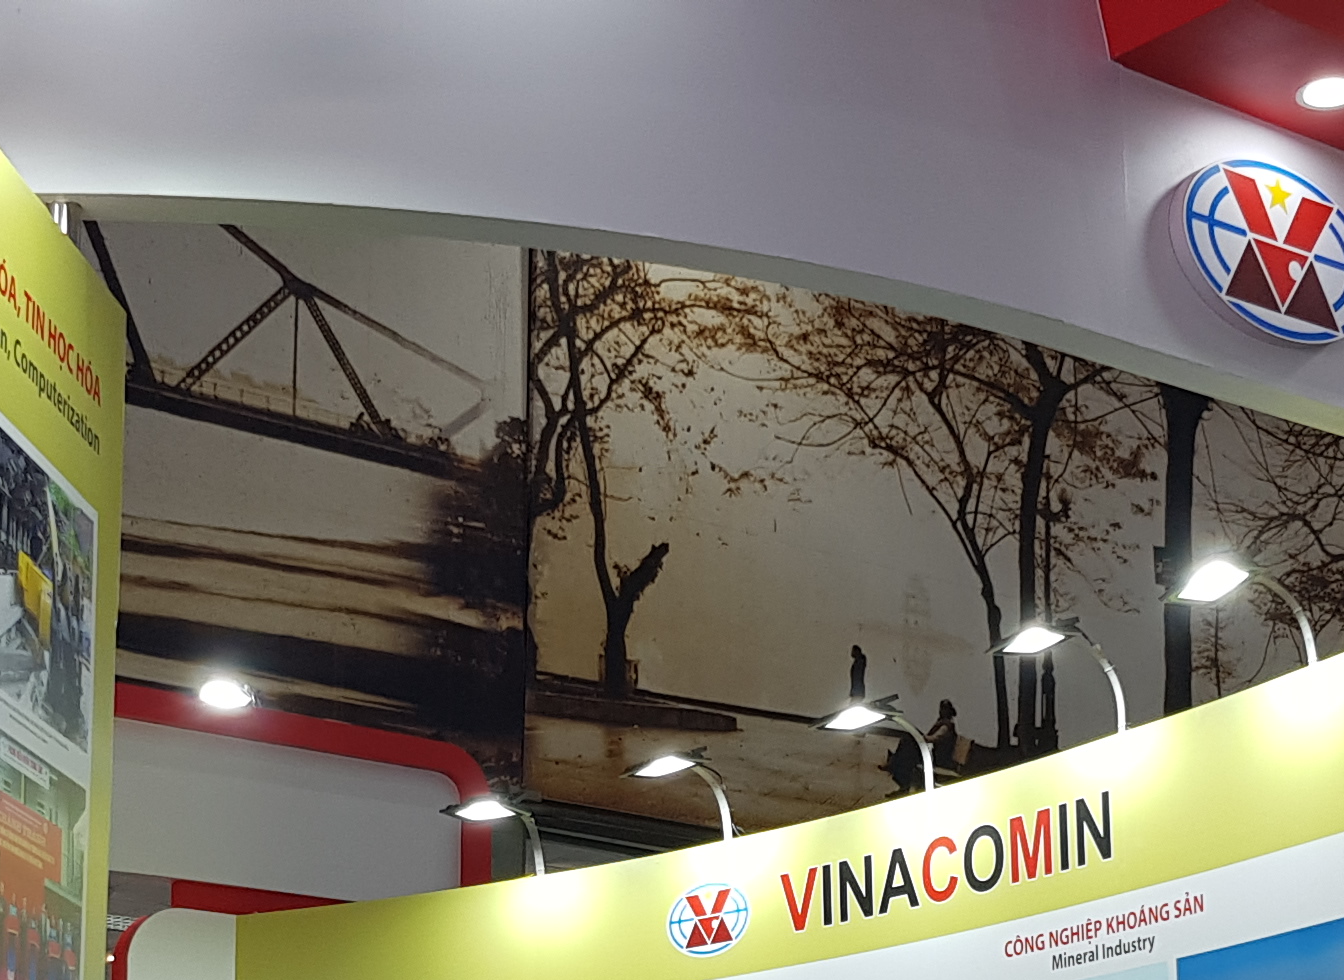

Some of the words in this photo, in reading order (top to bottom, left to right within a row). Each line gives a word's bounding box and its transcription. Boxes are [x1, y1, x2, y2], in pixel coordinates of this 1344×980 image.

[13, 338, 101, 456] Computerization
[24, 290, 45, 342] TIN
[47, 319, 74, 372] HỌC
[76, 352, 102, 408] HÓA
[780, 791, 1114, 932] VINACOMIN
[1005, 933, 1045, 957] CÔNG
[1049, 918, 1102, 948] NGHIỆP
[1106, 903, 1170, 935] KHOÁNG
[1174, 892, 1204, 919] SẢN
[1052, 944, 1098, 970] Mineral
[1102, 936, 1155, 959] Industry
